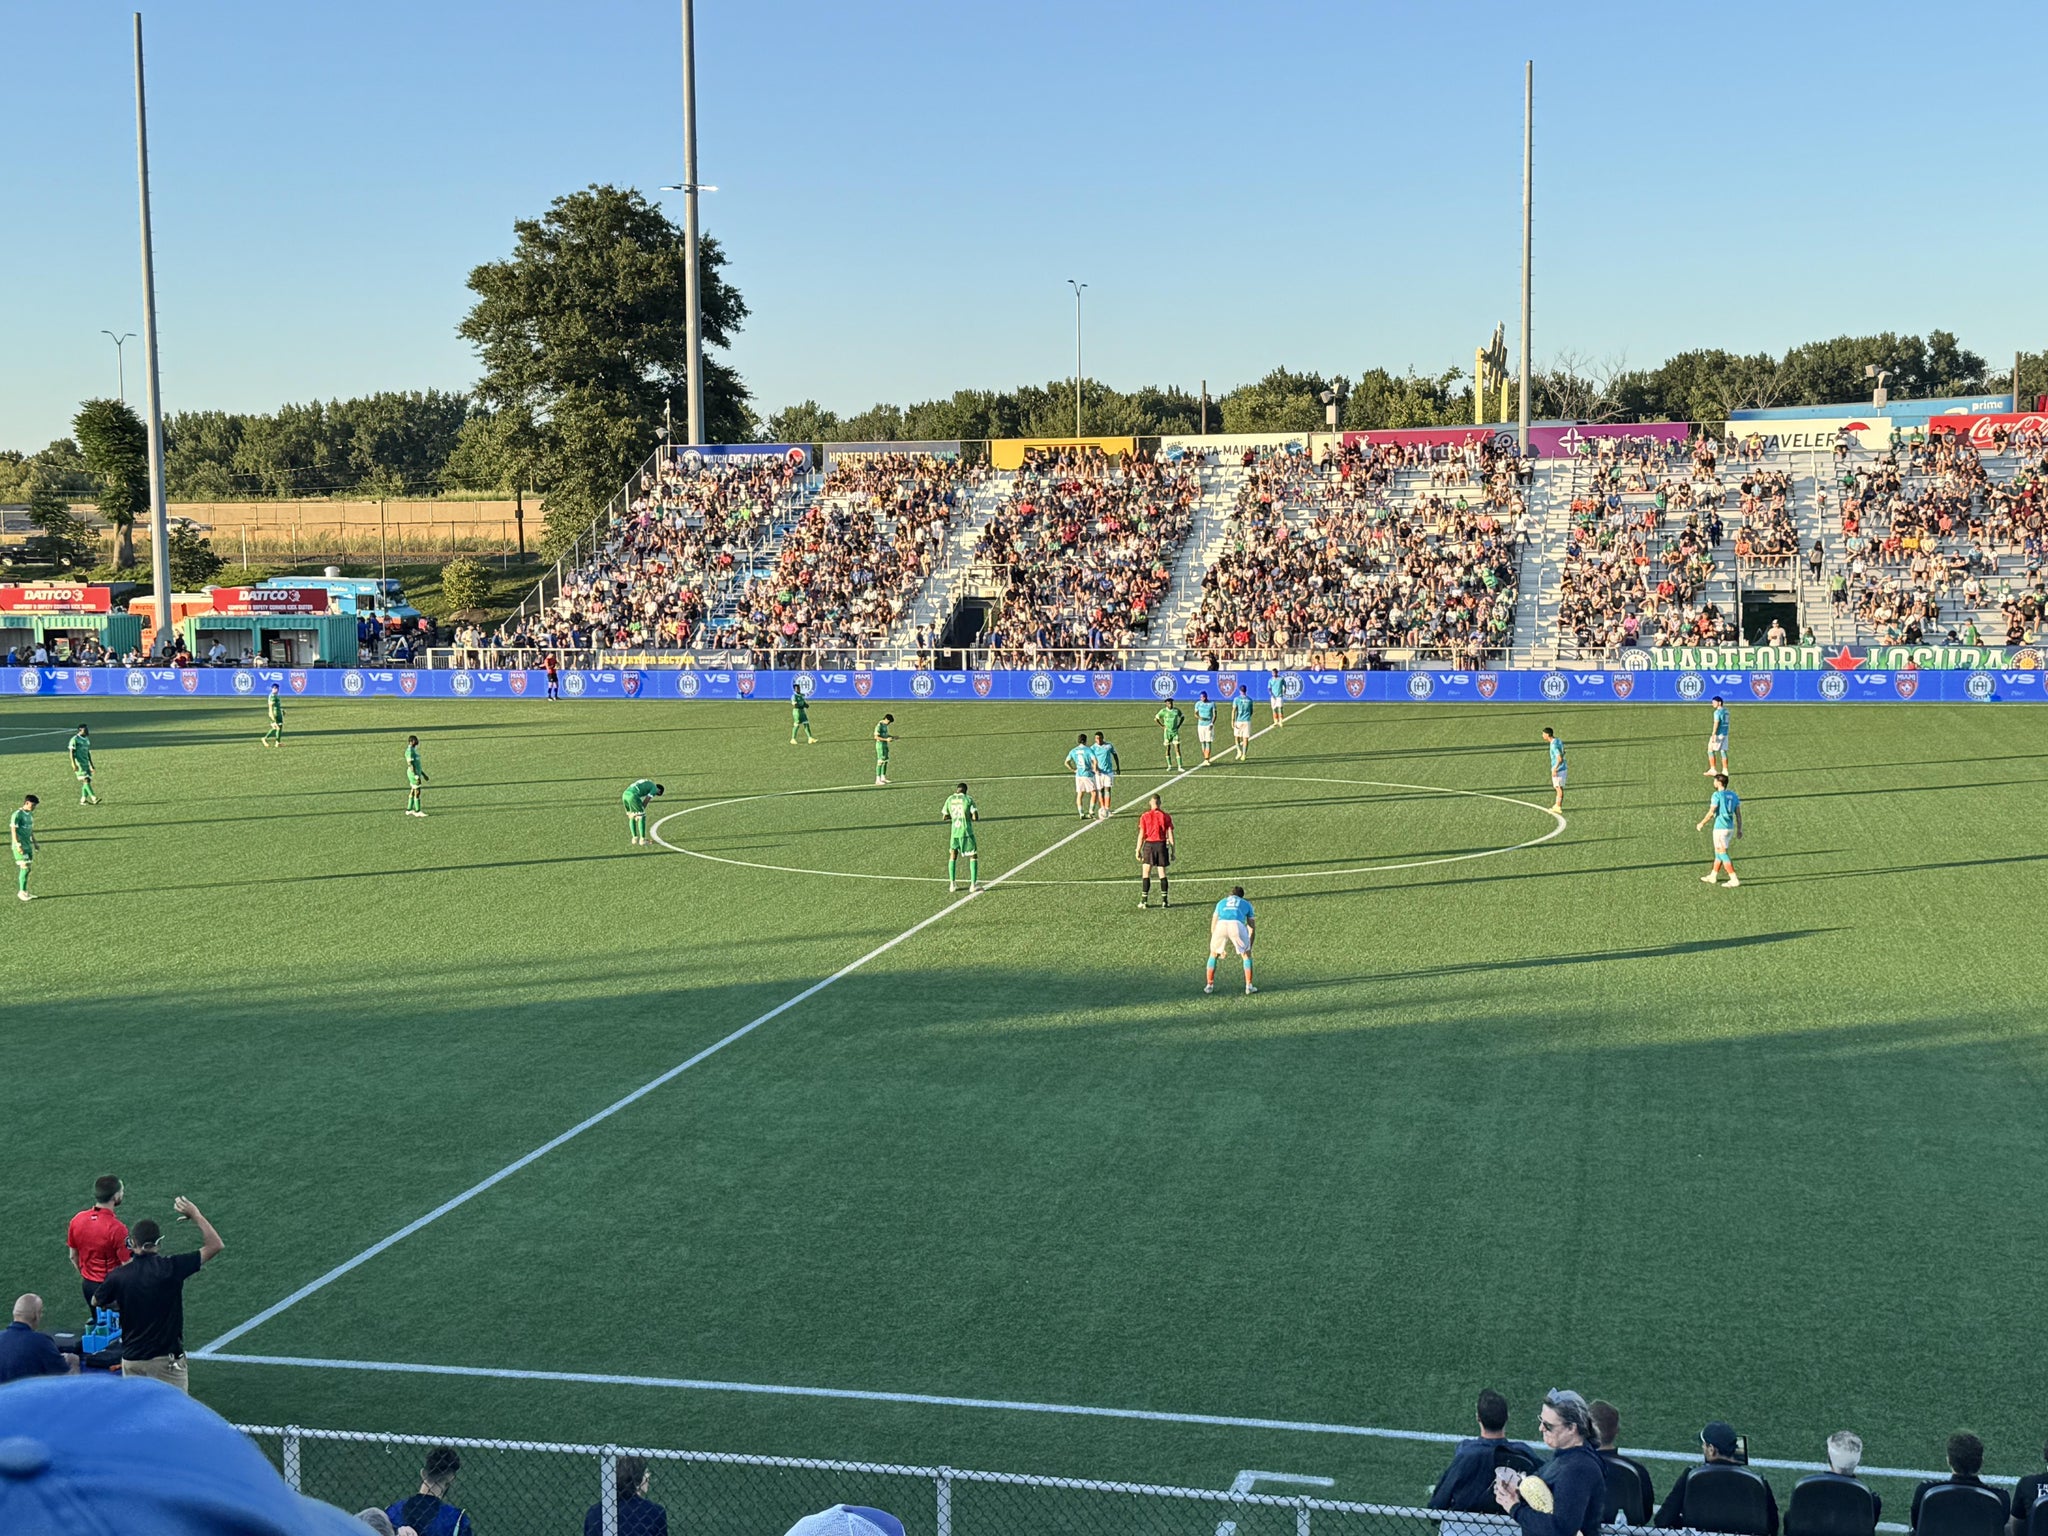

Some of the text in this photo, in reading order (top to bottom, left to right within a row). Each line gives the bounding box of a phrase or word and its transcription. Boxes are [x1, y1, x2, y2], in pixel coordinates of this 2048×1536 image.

[1972, 400, 2003, 412] prime
[1746, 433, 1845, 448] RAVELER
[703, 454, 727, 463] WATCH
[24, 590, 71, 600] DATTCO
[239, 590, 287, 600] DATTCO
[1655, 648, 1822, 670] HARTFORD
[45, 671, 69, 680] VS
[151, 671, 175, 680] VS
[259, 672, 283, 681] VS
[368, 673, 393, 682] VS
[478, 673, 502, 682] VS
[590, 673, 615, 683] VS
[704, 674, 730, 683] VS
[821, 674, 847, 683] VS
[939, 674, 966, 683] VS
[1059, 674, 1086, 684] VS
[1182, 674, 1210, 684] VS
[1309, 674, 1338, 684] VS
[1439, 674, 1469, 684] VS
[1574, 674, 1605, 684] VS
[1711, 674, 1742, 684] VS
[1854, 674, 1887, 684] VS
[2002, 674, 2035, 684] VS
